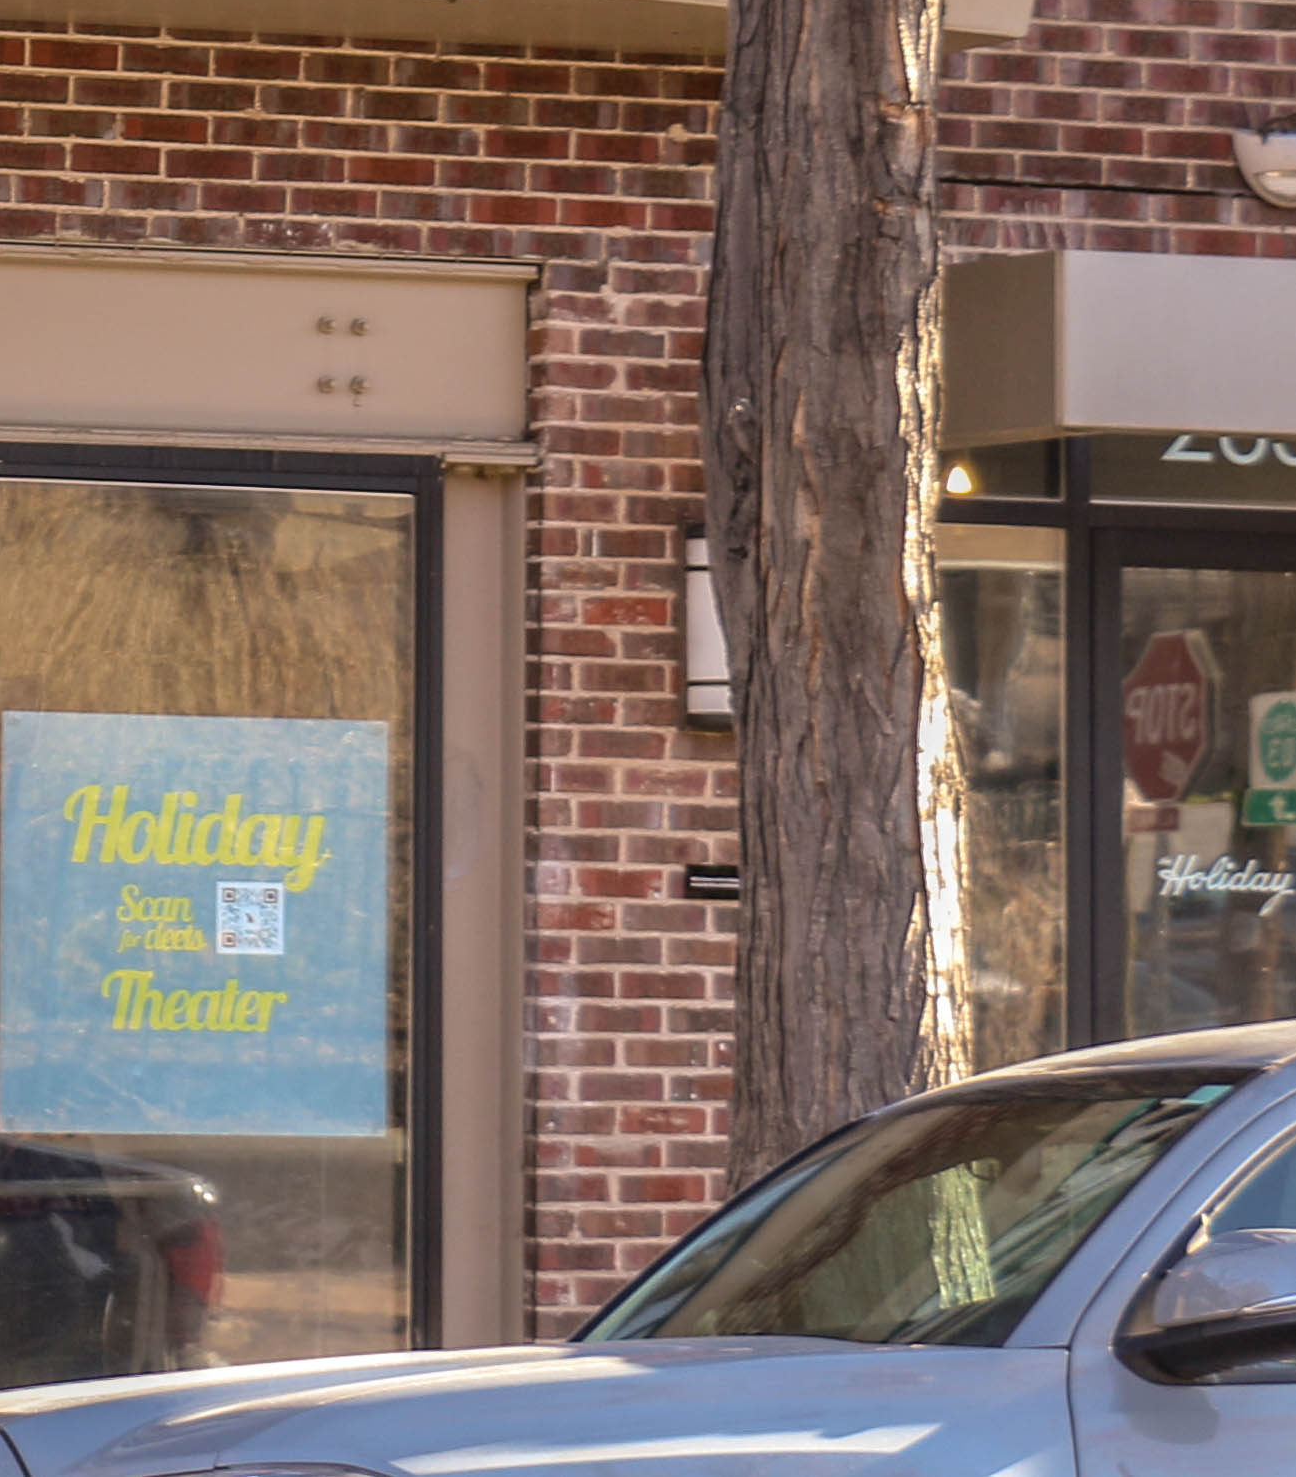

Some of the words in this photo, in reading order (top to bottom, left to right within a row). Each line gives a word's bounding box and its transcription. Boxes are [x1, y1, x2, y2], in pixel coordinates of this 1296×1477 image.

[63, 784, 332, 892] Holiday
[116, 884, 195, 921] Scan
[1157, 854, 1296, 916] Holiday
[117, 929, 142, 953] for
[101, 969, 288, 1032] Theater
